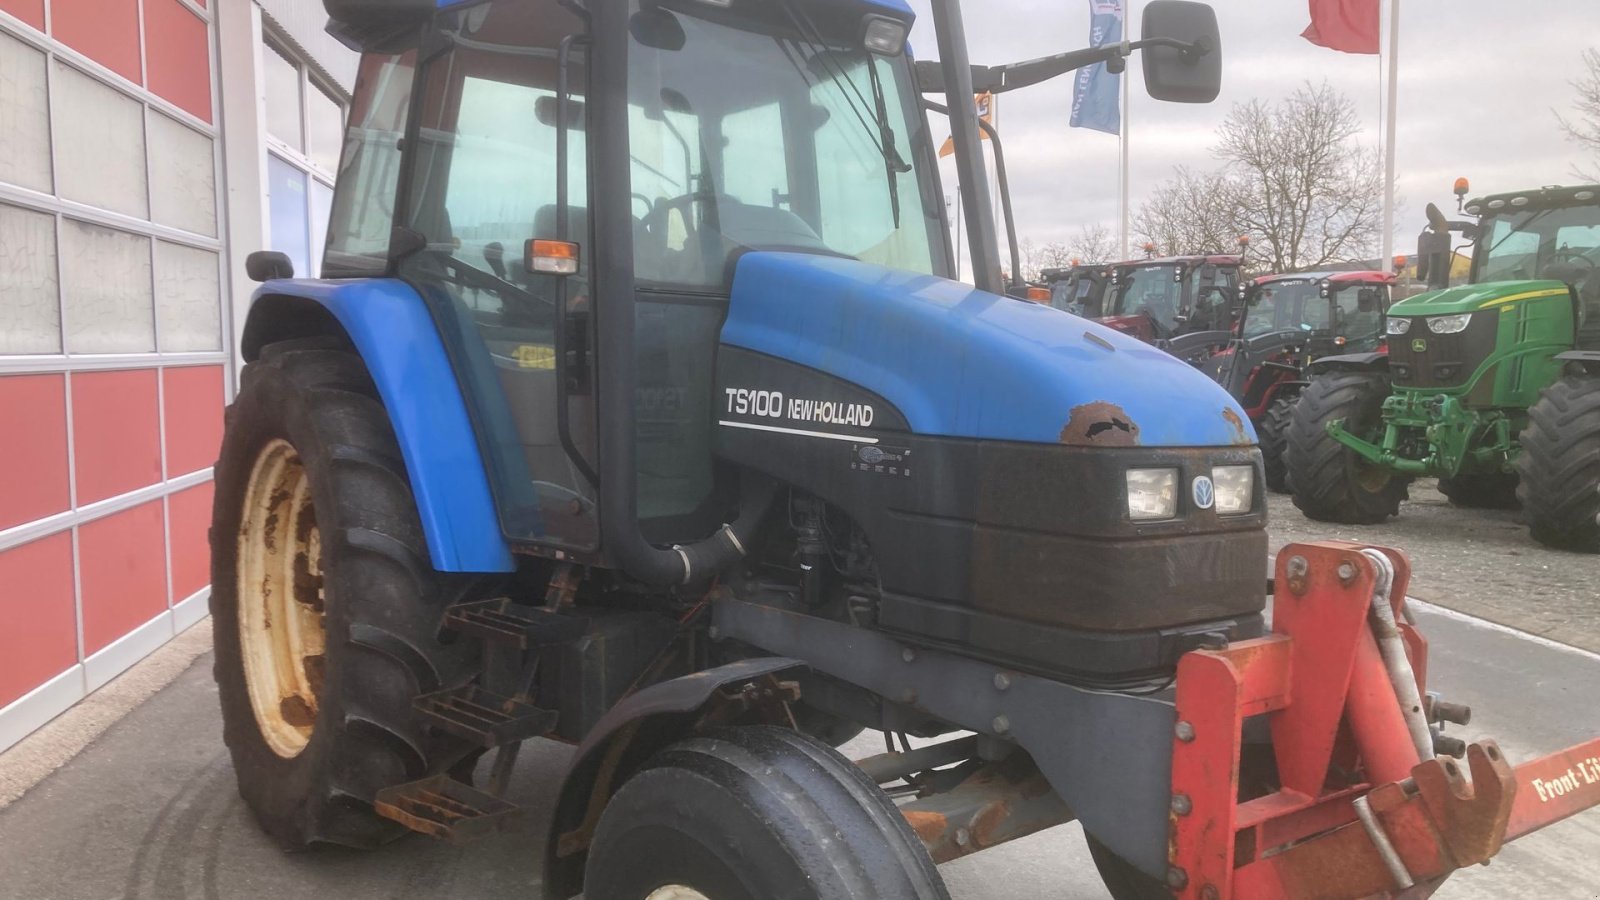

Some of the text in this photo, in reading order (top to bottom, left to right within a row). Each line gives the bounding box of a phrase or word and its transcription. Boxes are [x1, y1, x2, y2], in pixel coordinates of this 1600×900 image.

[726, 388, 874, 427] TS100 NEW HOLLAND
